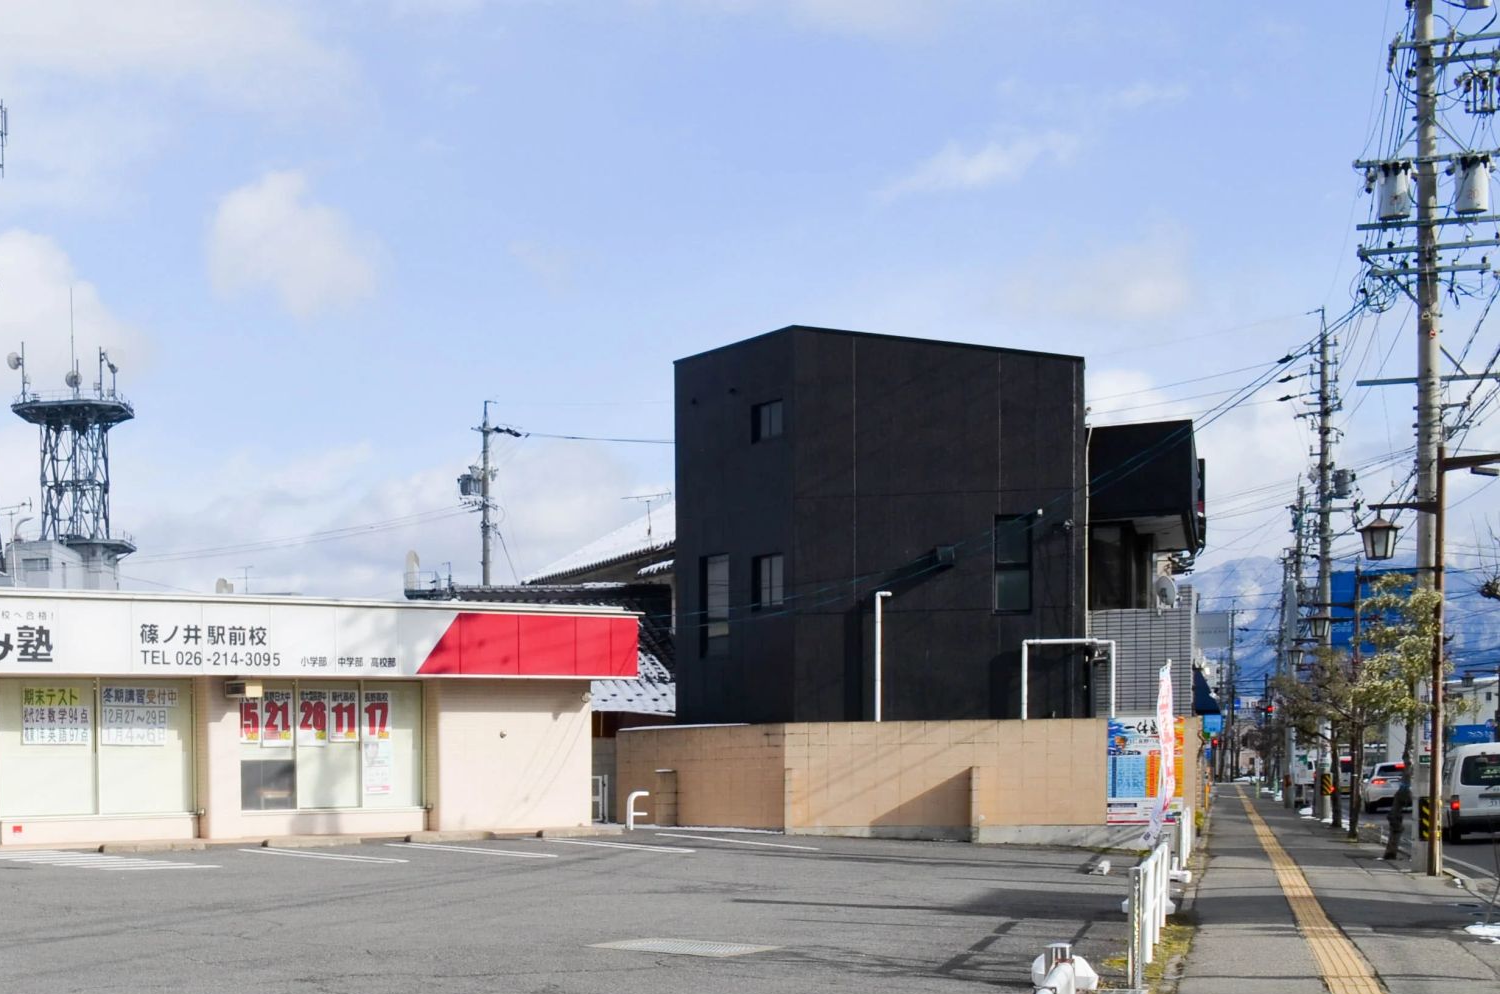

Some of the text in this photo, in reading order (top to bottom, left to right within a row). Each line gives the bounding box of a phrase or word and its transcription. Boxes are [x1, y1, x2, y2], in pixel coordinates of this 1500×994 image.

[140, 624, 267, 646] 篠ノ井駅前校
[140, 650, 171, 665] TEL
[338, 656, 364, 667] 中学部
[371, 657, 397, 668] 高校部
[24, 688, 78, 706] 期末テスト
[103, 688, 178, 706] 冬期講習受付中
[264, 701, 291, 732] 21
[300, 701, 327, 731] 26
[332, 702, 356, 733] 11
[364, 703, 389, 736] 17
